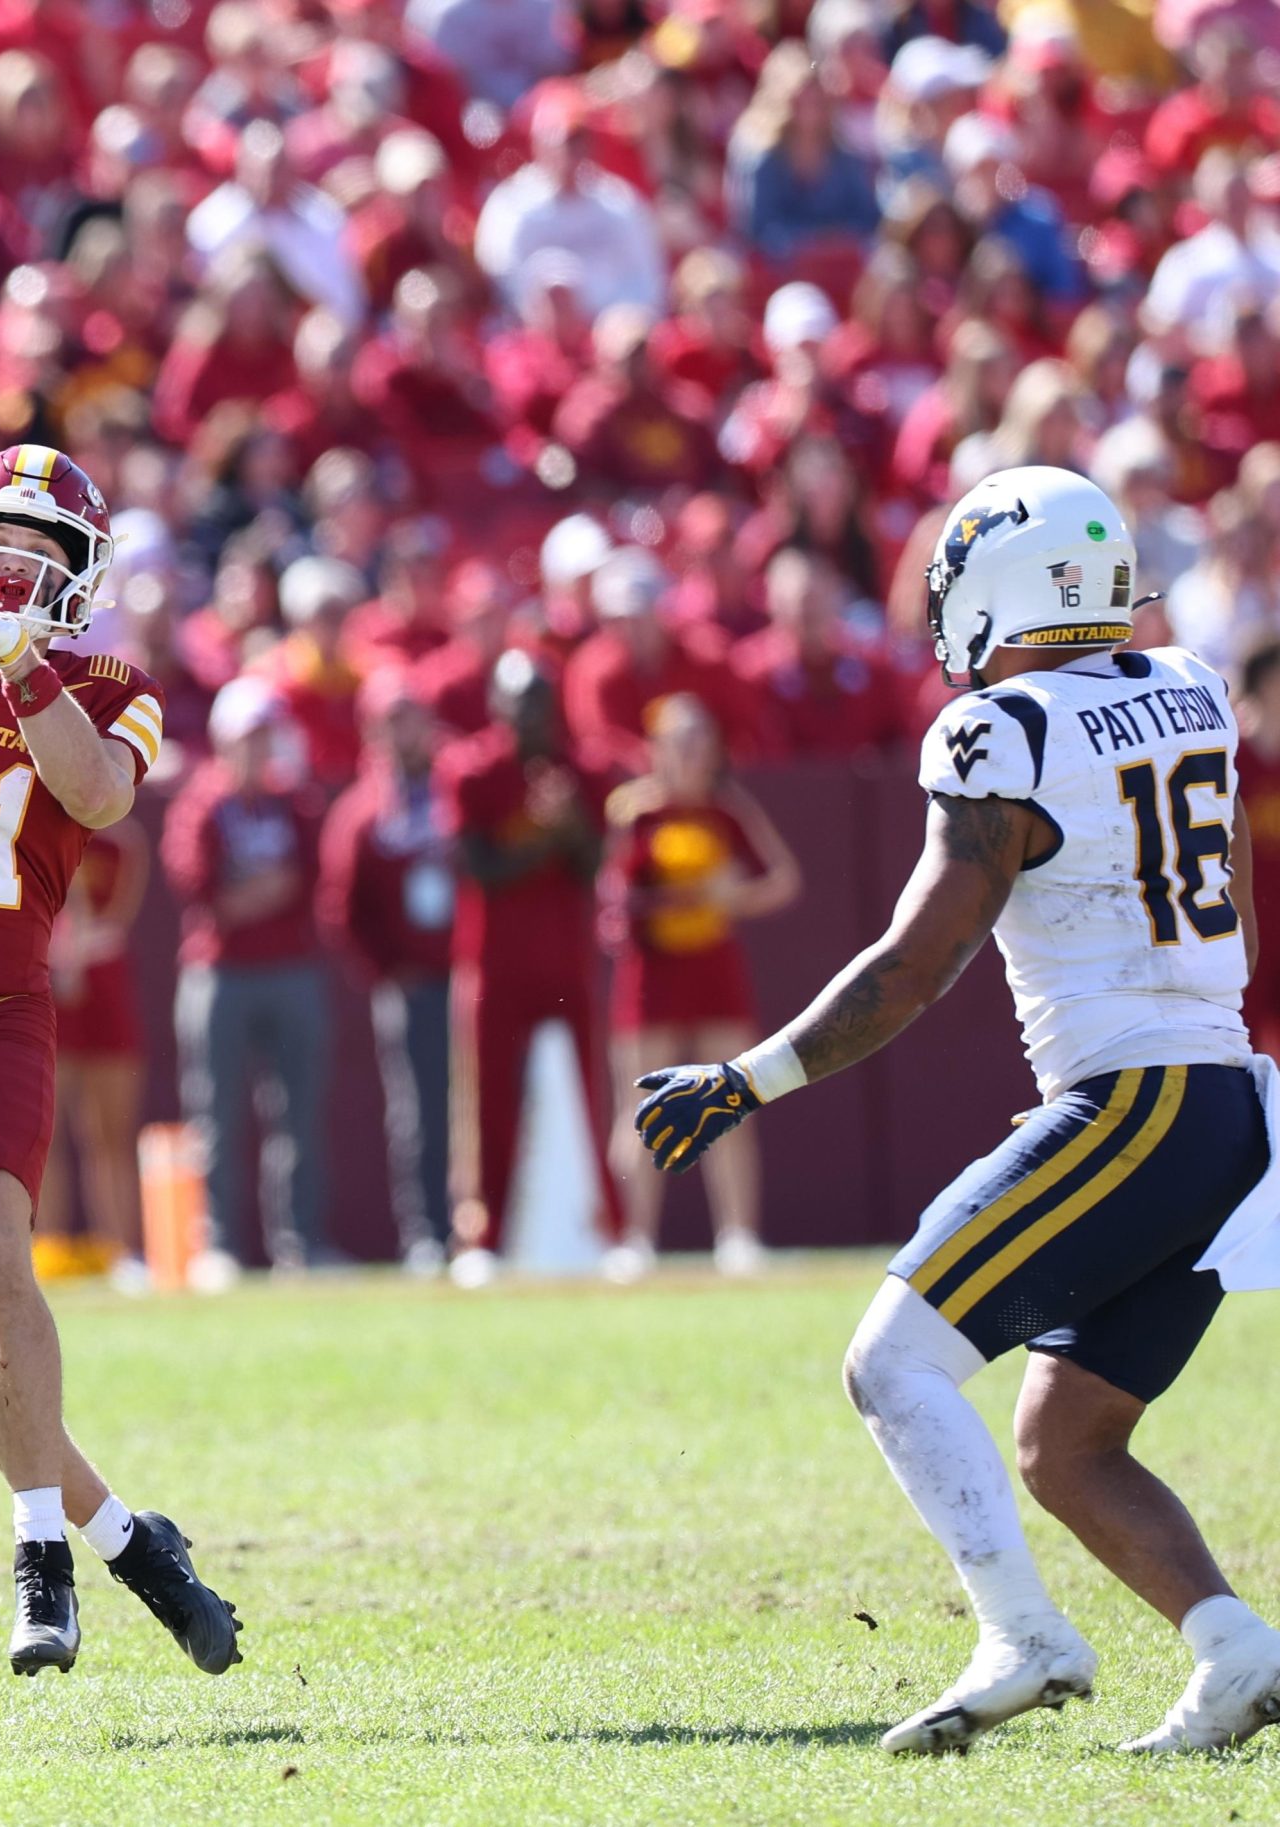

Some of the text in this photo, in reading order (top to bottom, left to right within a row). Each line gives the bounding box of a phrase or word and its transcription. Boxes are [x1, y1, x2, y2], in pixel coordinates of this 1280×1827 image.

[1060, 584, 1081, 608] 16
[1077, 685, 1228, 755] PATTERSON
[1115, 746, 1241, 947] 16
